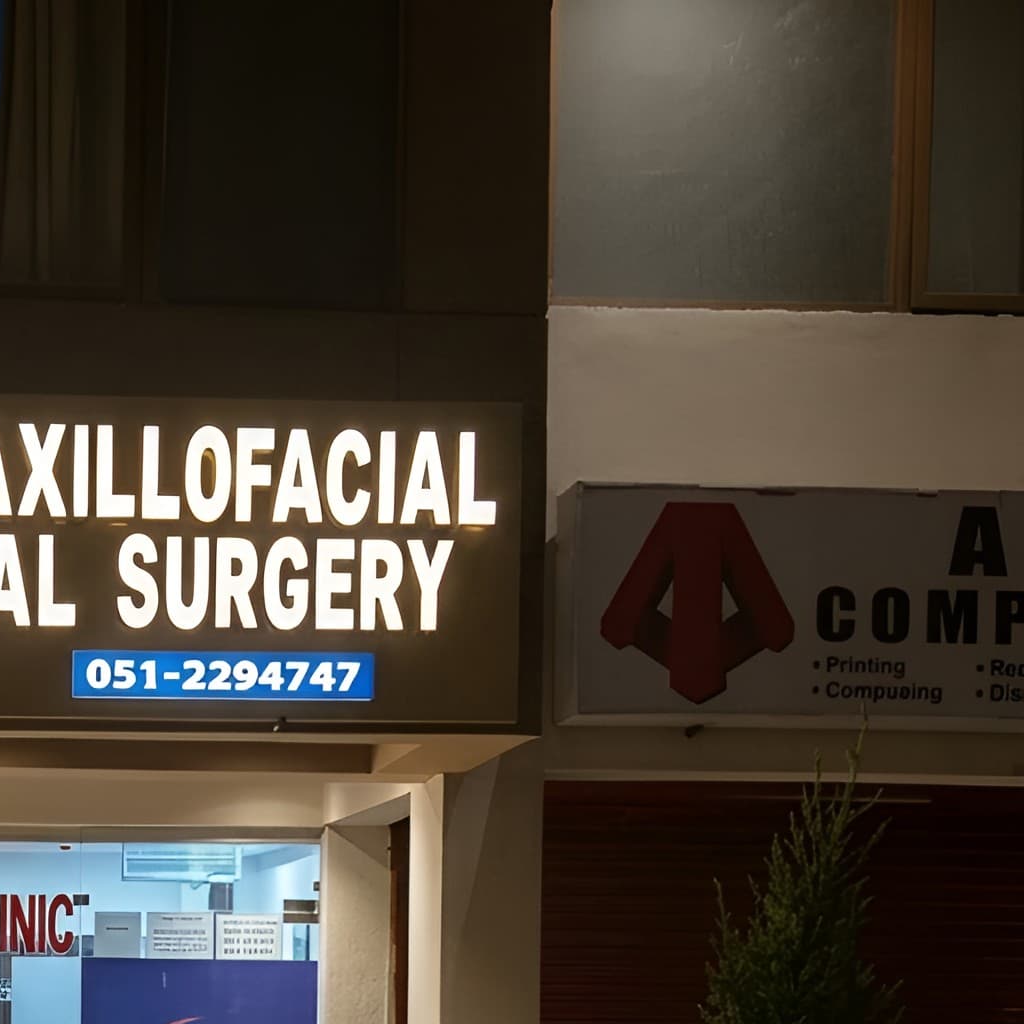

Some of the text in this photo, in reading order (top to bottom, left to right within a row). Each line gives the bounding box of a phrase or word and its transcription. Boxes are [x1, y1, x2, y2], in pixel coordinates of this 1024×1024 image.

[947, 505, 1008, 577] A
[116, 532, 455, 632] SURGERY
[815, 586, 1024, 645] COMP
[86, 658, 361, 693] 051-2294747
[826, 656, 906, 679] Printing
